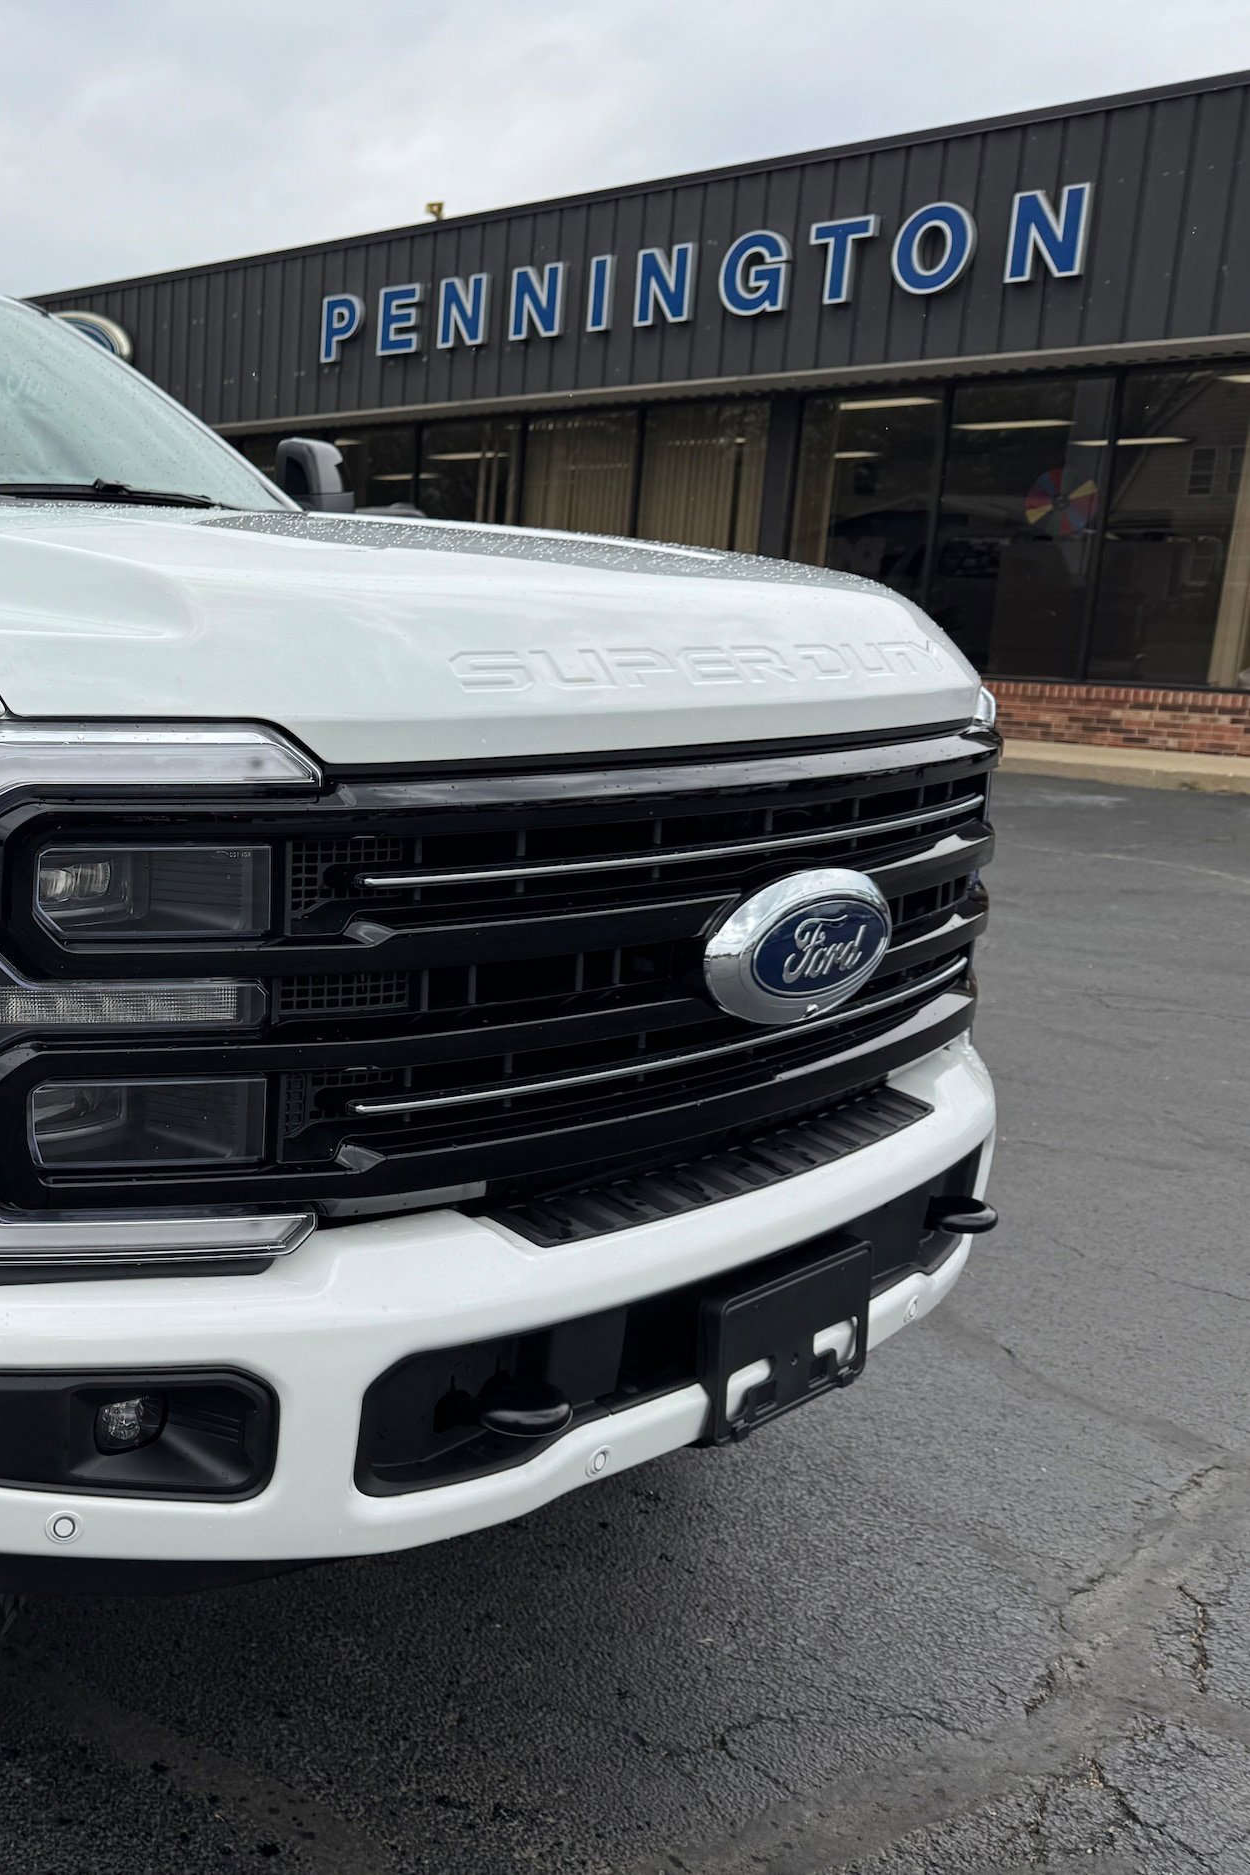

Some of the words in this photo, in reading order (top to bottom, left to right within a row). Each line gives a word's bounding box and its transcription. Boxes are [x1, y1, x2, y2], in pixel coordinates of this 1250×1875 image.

[319, 182, 1093, 364] PENNINGTON
[449, 645, 798, 693] SUPER
[794, 641, 944, 680] DUTY
[782, 914, 867, 984] Ford
